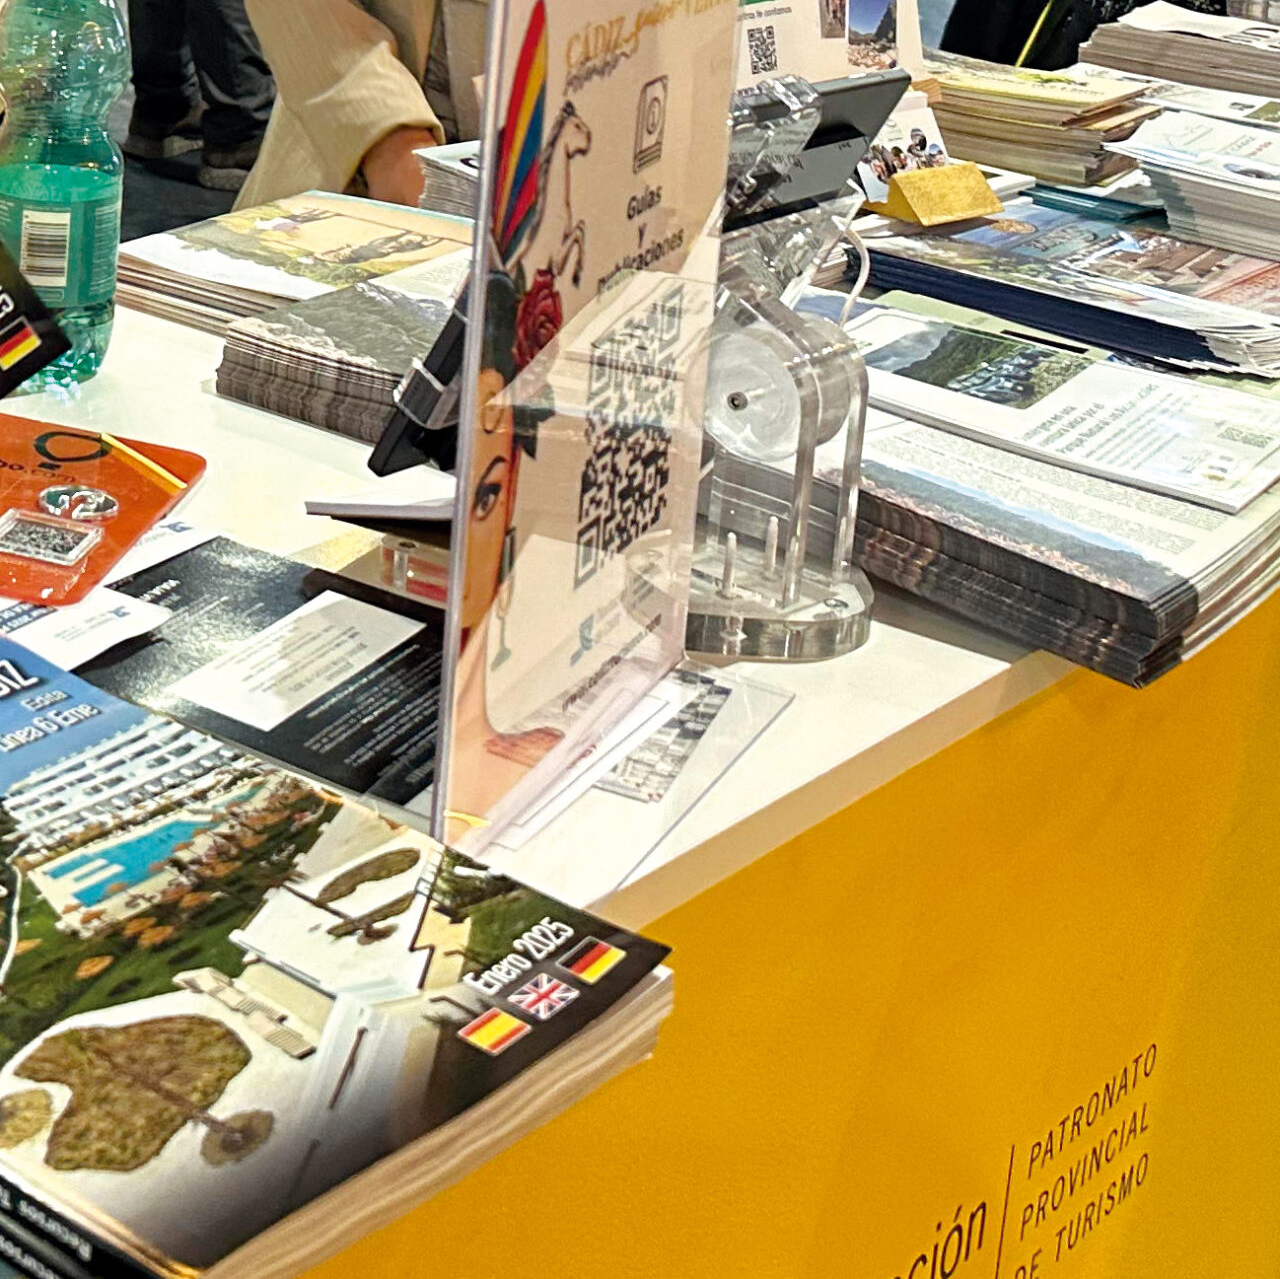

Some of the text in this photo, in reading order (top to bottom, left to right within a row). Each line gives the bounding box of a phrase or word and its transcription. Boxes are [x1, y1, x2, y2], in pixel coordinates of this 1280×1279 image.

[626, 184, 664, 221] Guías
[21, 688, 69, 712] Edita
[37, 715, 58, 734] 6
[52, 700, 104, 730] Eme
[463, 916, 575, 996] Enero 2025
[894, 1042, 1158, 1279] ción PATRONATO
[1020, 1102, 1149, 1243] PROVINCIAL
[18, 1198, 93, 1262] Recursos
[1055, 1152, 1149, 1263] TURISMO
